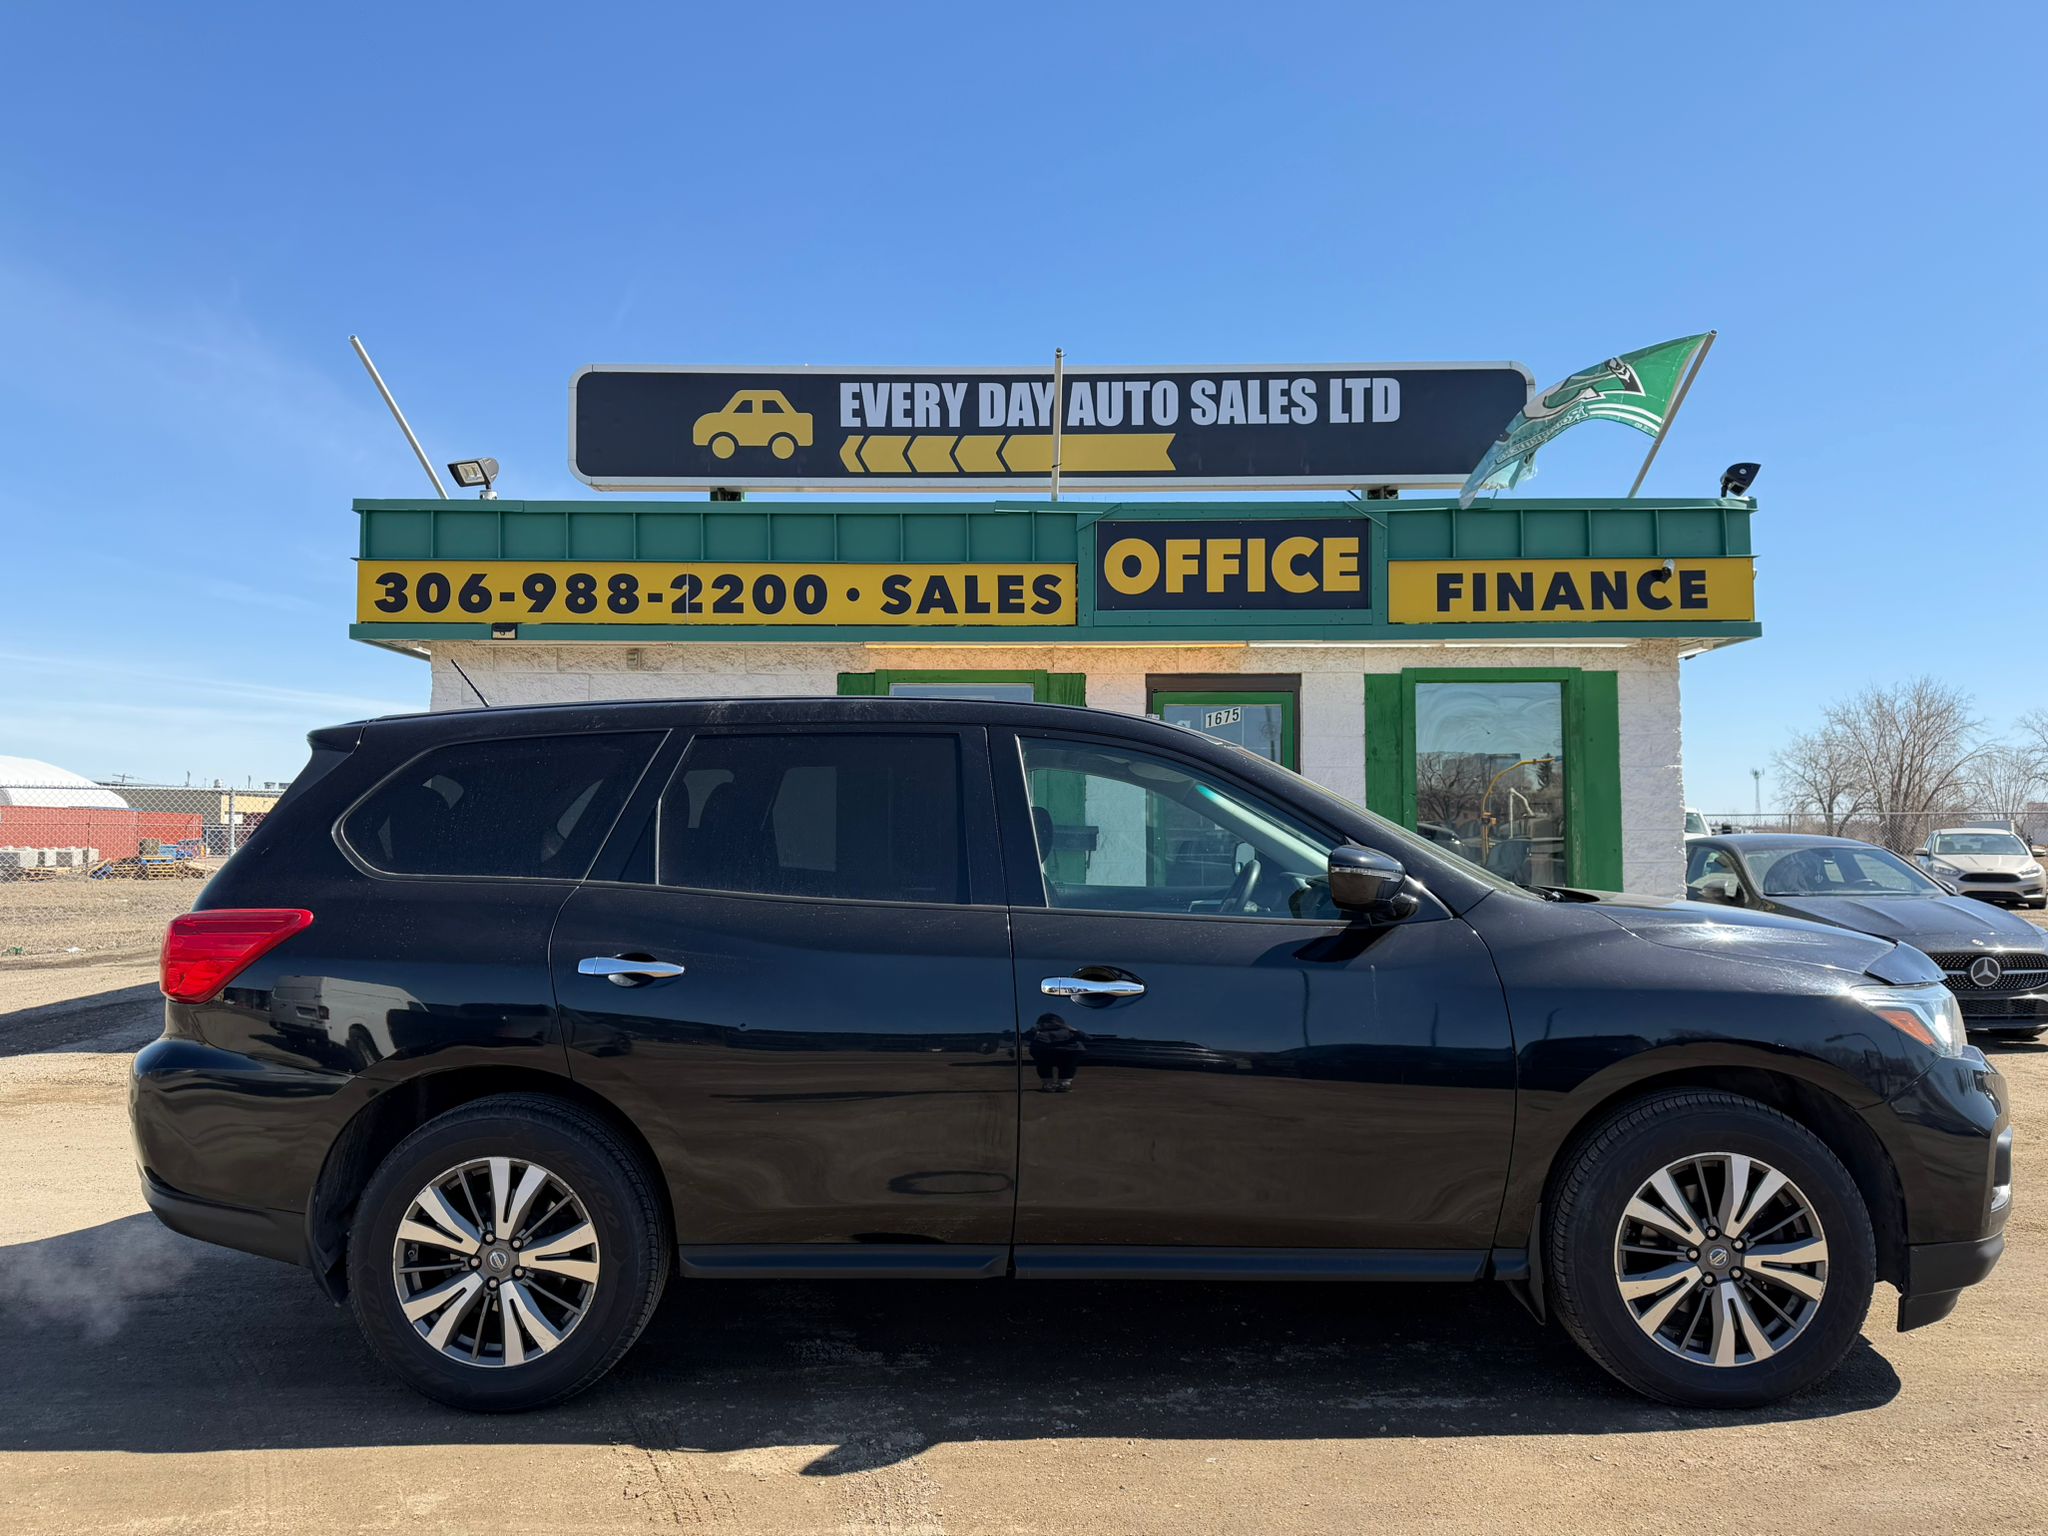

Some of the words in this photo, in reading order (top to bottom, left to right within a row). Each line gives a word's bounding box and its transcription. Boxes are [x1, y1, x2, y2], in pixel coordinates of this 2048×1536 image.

[840, 383, 968, 428] EVERY
[979, 383, 1054, 427] DAY
[1067, 380, 1179, 426] AUTO
[1191, 378, 1318, 425] SALES
[1330, 378, 1401, 424] LTD
[1104, 537, 1361, 594] OFFICE
[375, 572, 827, 615] 306-988-2200
[881, 574, 1062, 615] SALES
[1437, 570, 1709, 612] FINANCE
[1207, 708, 1240, 727] 1675
